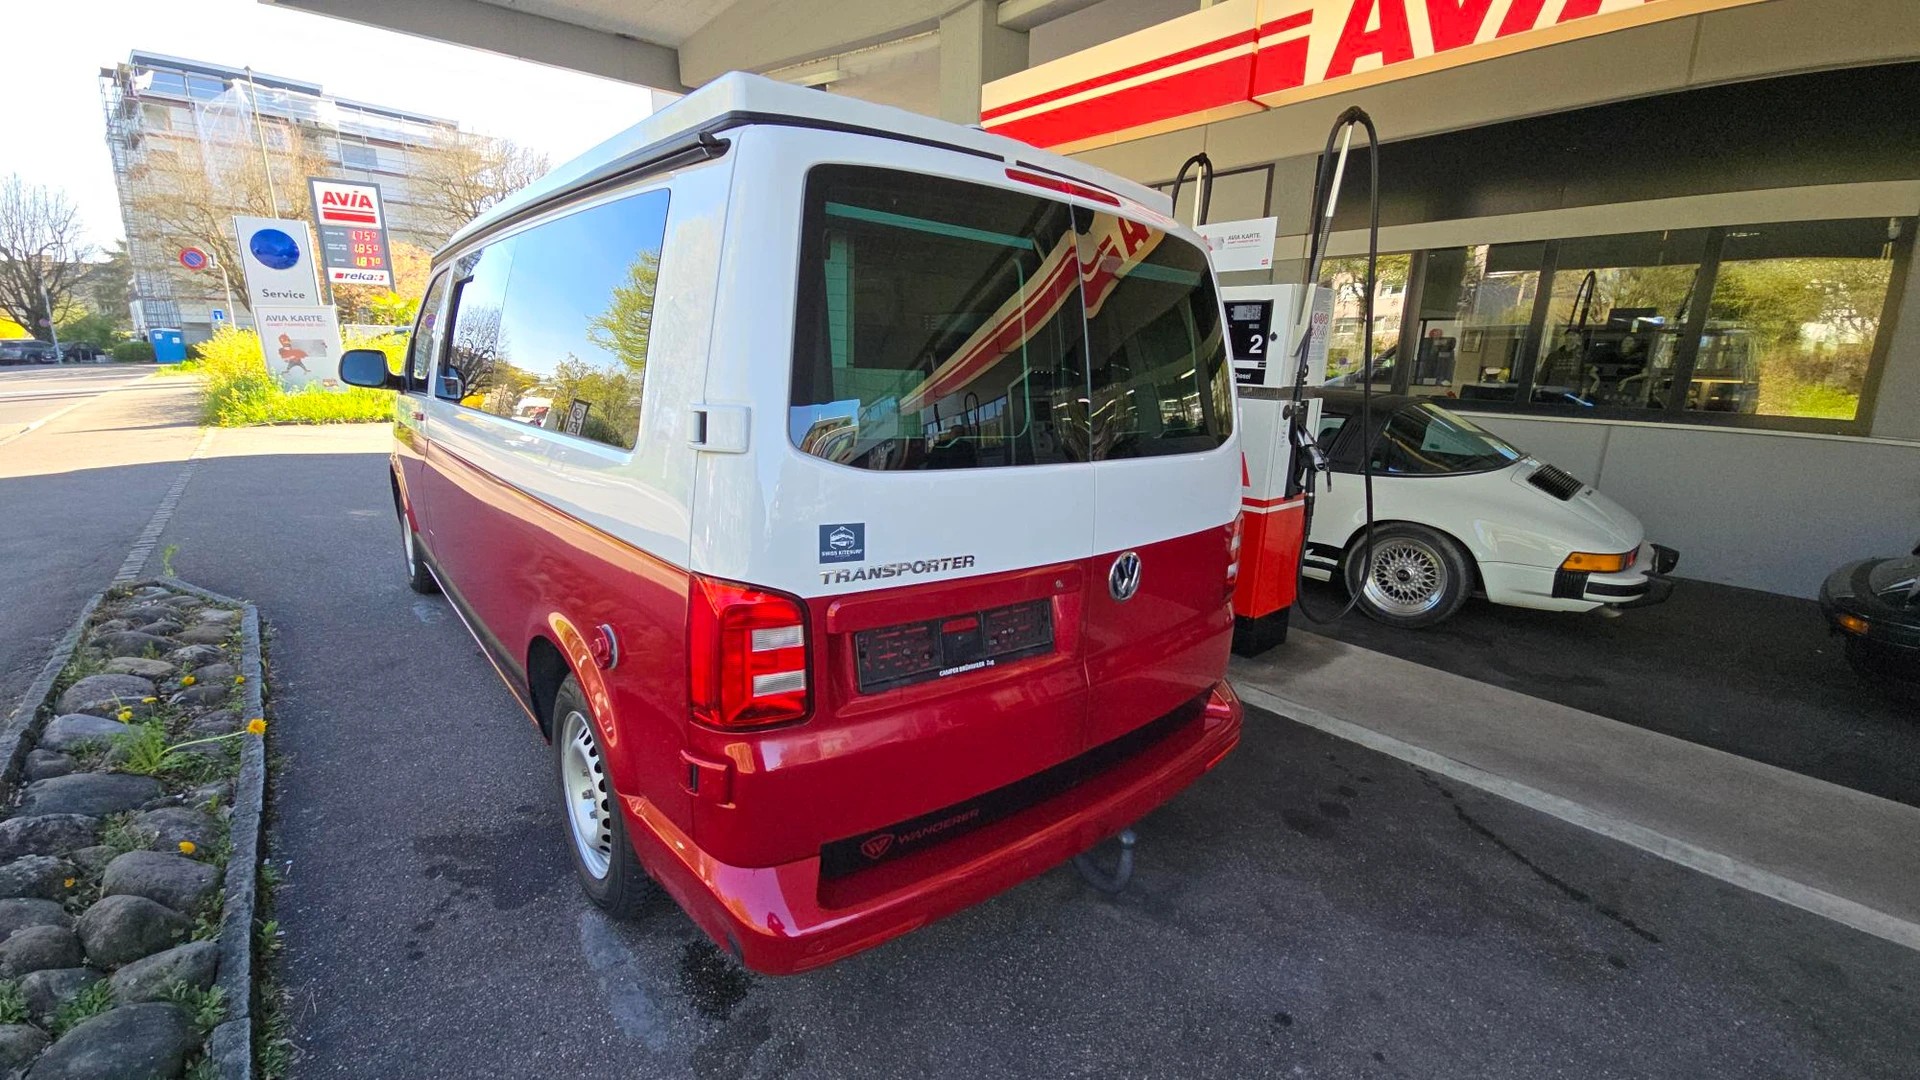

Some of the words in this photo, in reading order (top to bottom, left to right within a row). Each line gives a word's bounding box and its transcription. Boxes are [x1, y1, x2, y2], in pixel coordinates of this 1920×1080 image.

[322, 190, 374, 209] AVIA
[262, 288, 306, 300] Service
[265, 314, 289, 322] AVIA
[1248, 334, 1263, 354] 2
[819, 555, 975, 585] TRANSPORTER
[898, 808, 980, 845] WANDERER
